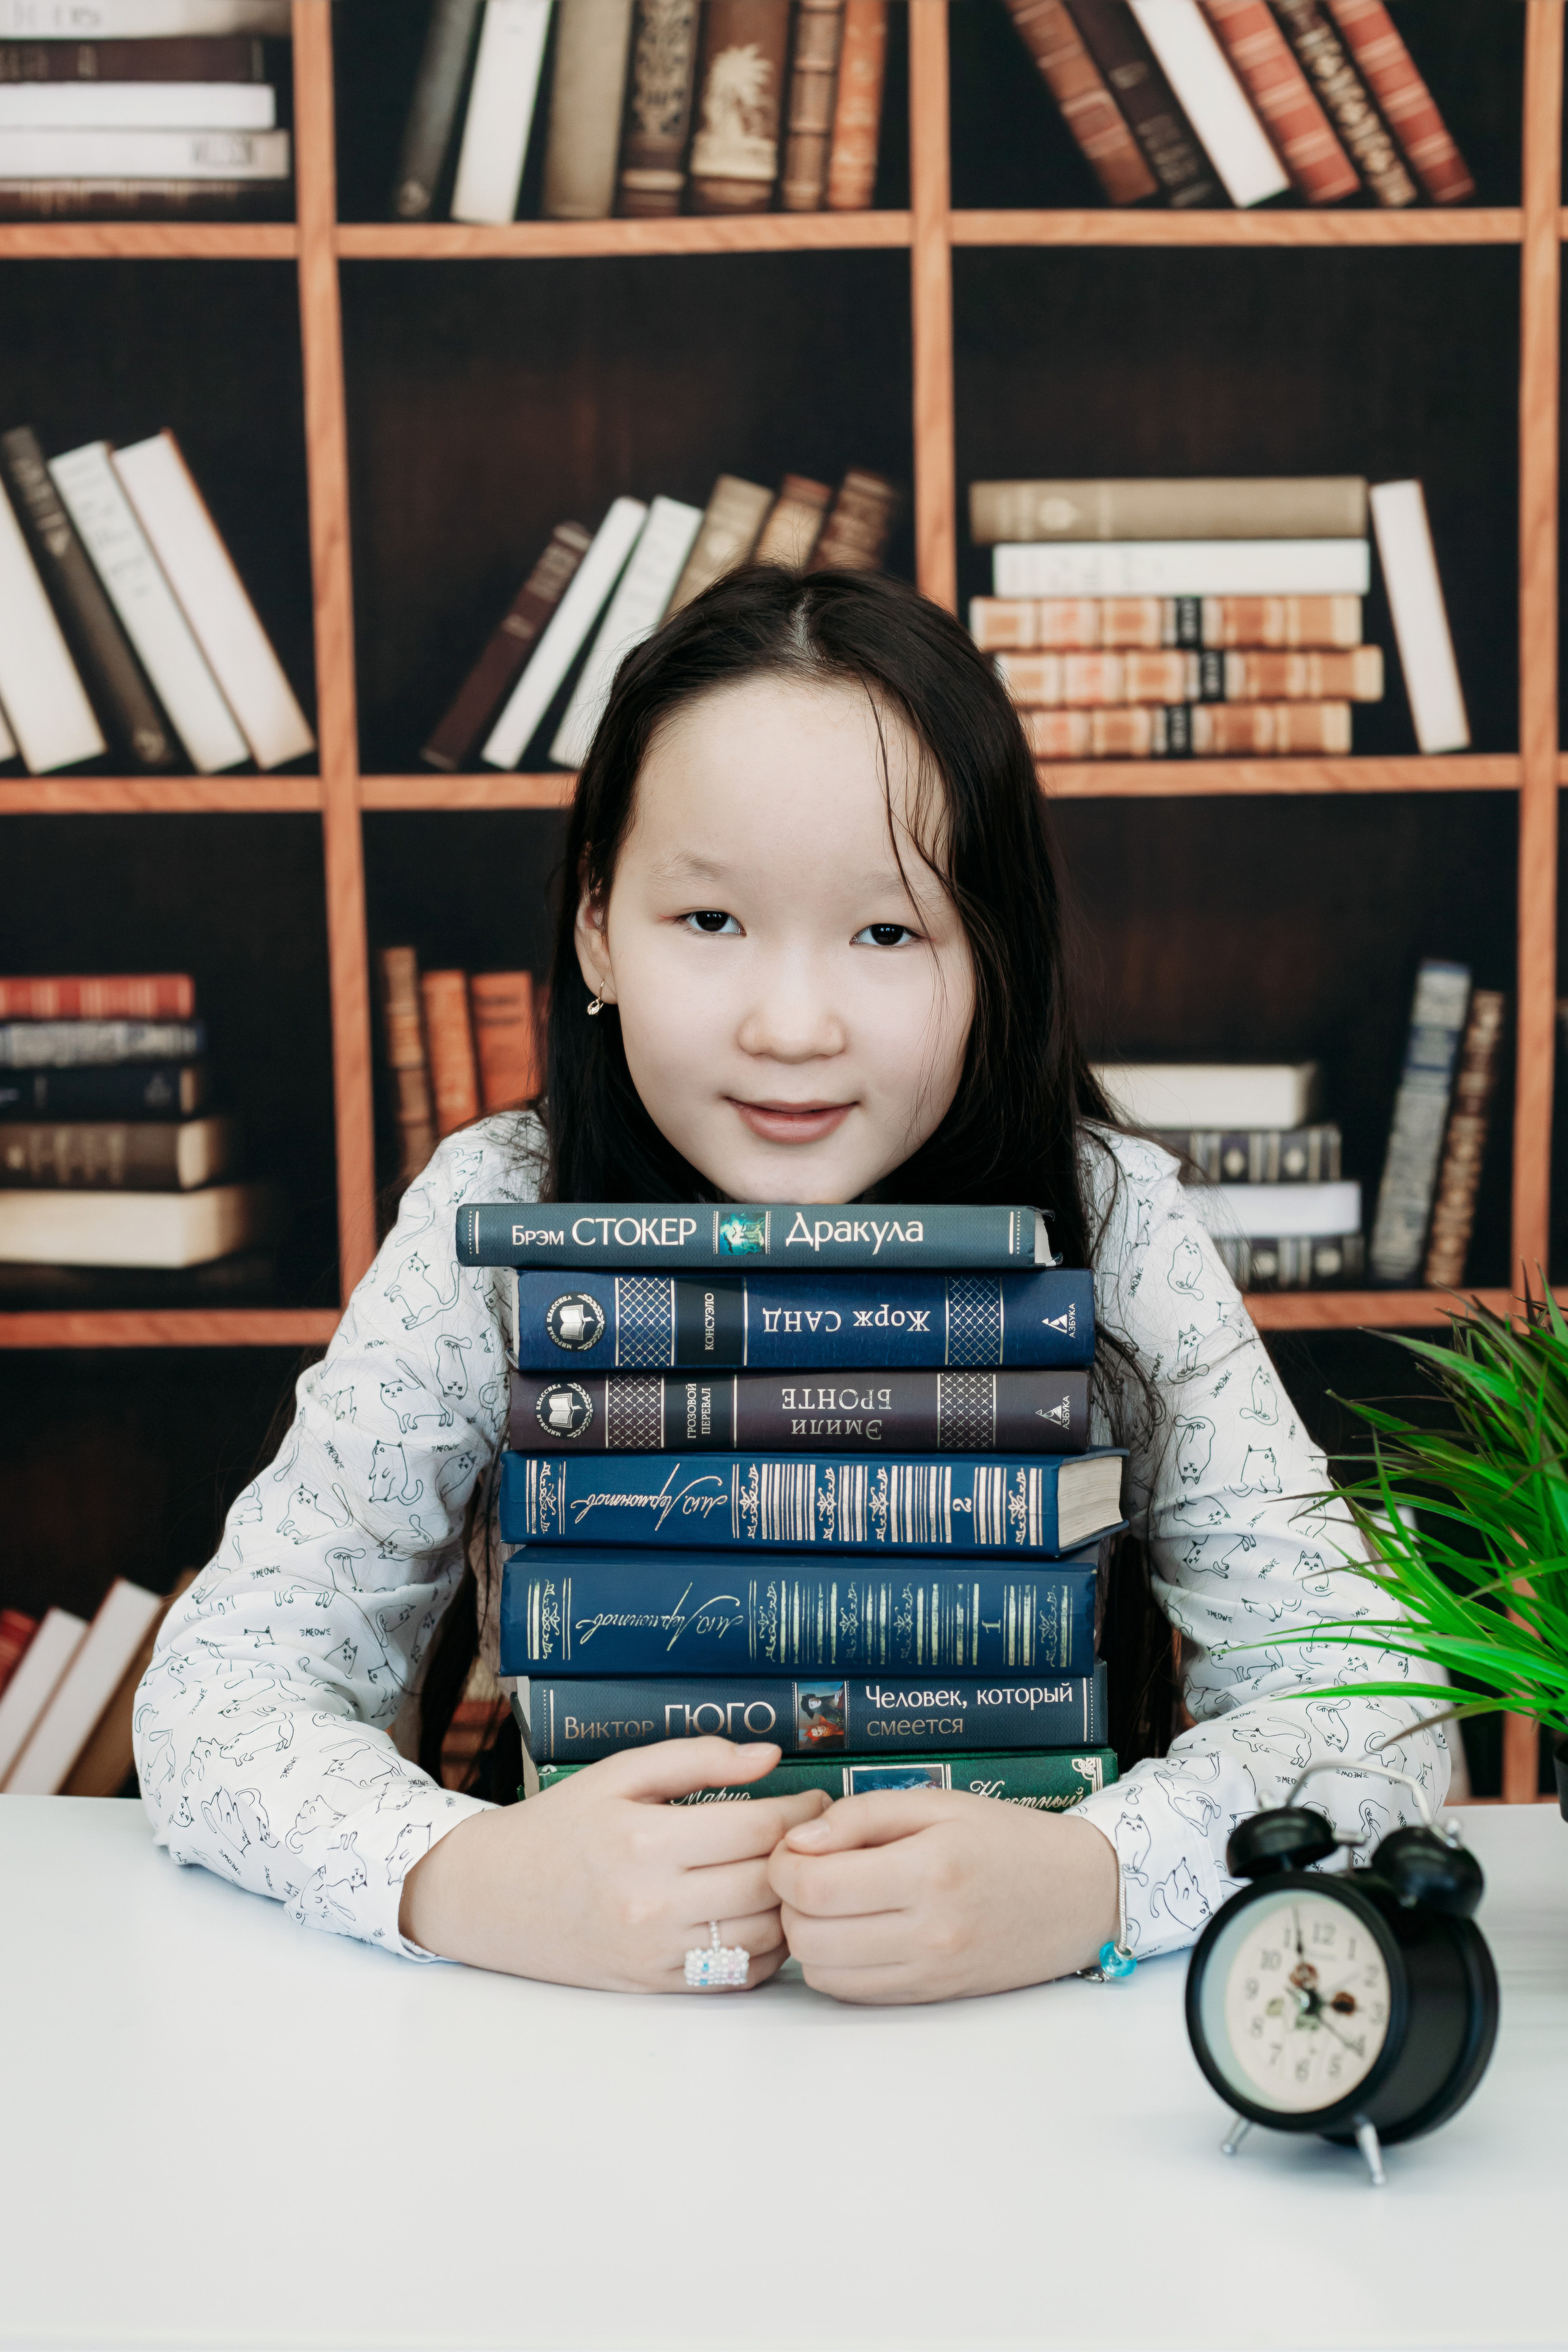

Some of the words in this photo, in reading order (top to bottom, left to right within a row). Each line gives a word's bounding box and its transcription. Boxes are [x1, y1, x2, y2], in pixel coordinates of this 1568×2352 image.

[571, 1218, 696, 1246] СТОКЕР
[785, 1212, 924, 1254] Дракула
[546, 1295, 572, 1322] КЛАССИКА
[762, 1307, 842, 1333] САНД
[853, 1305, 931, 1332] Жорж
[704, 1292, 715, 1351] КОНСУЭЛО
[547, 1326, 572, 1349] МИРОВАЯ
[536, 1384, 561, 1410] КЛАССИКА
[782, 1389, 892, 1410] БРОНТЕ
[685, 1382, 697, 1439] ГРОЗОВОЙ
[701, 1387, 711, 1434] ПЕРЕВАЛ
[1061, 1395, 1070, 1430] АЗБУКА
[537, 1414, 561, 1436] МИРОВАЯ
[328, 1445, 341, 1466] MEOW
[952, 1498, 972, 1512] 2
[256, 1567, 275, 1578] MEOW
[1260, 1561, 1275, 1576] MEOW
[981, 1619, 1001, 1634] 1
[1211, 1610, 1228, 1622] MEOW
[306, 1627, 326, 1636] MEOW
[865, 1685, 967, 1709] Человек,
[977, 1683, 1073, 1710] который
[664, 1701, 777, 1736] ГЮГО
[867, 1717, 963, 1736] смеется
[1231, 1711, 1251, 1721] MEOW
[282, 1760, 296, 1774] MEOW
[223, 1853, 238, 1871] MEOW
[1312, 1921, 1336, 1946] 12
[1260, 1949, 1283, 1972] 10
[1349, 1937, 1356, 1961] 1
[1364, 1964, 1379, 1988] 2
[1244, 1977, 1260, 2002] 9
[1250, 2016, 1265, 2040] 8
[1269, 2041, 1283, 2067] 7
[1294, 2057, 1310, 2083] 6
[1327, 2054, 1342, 2080] 5
